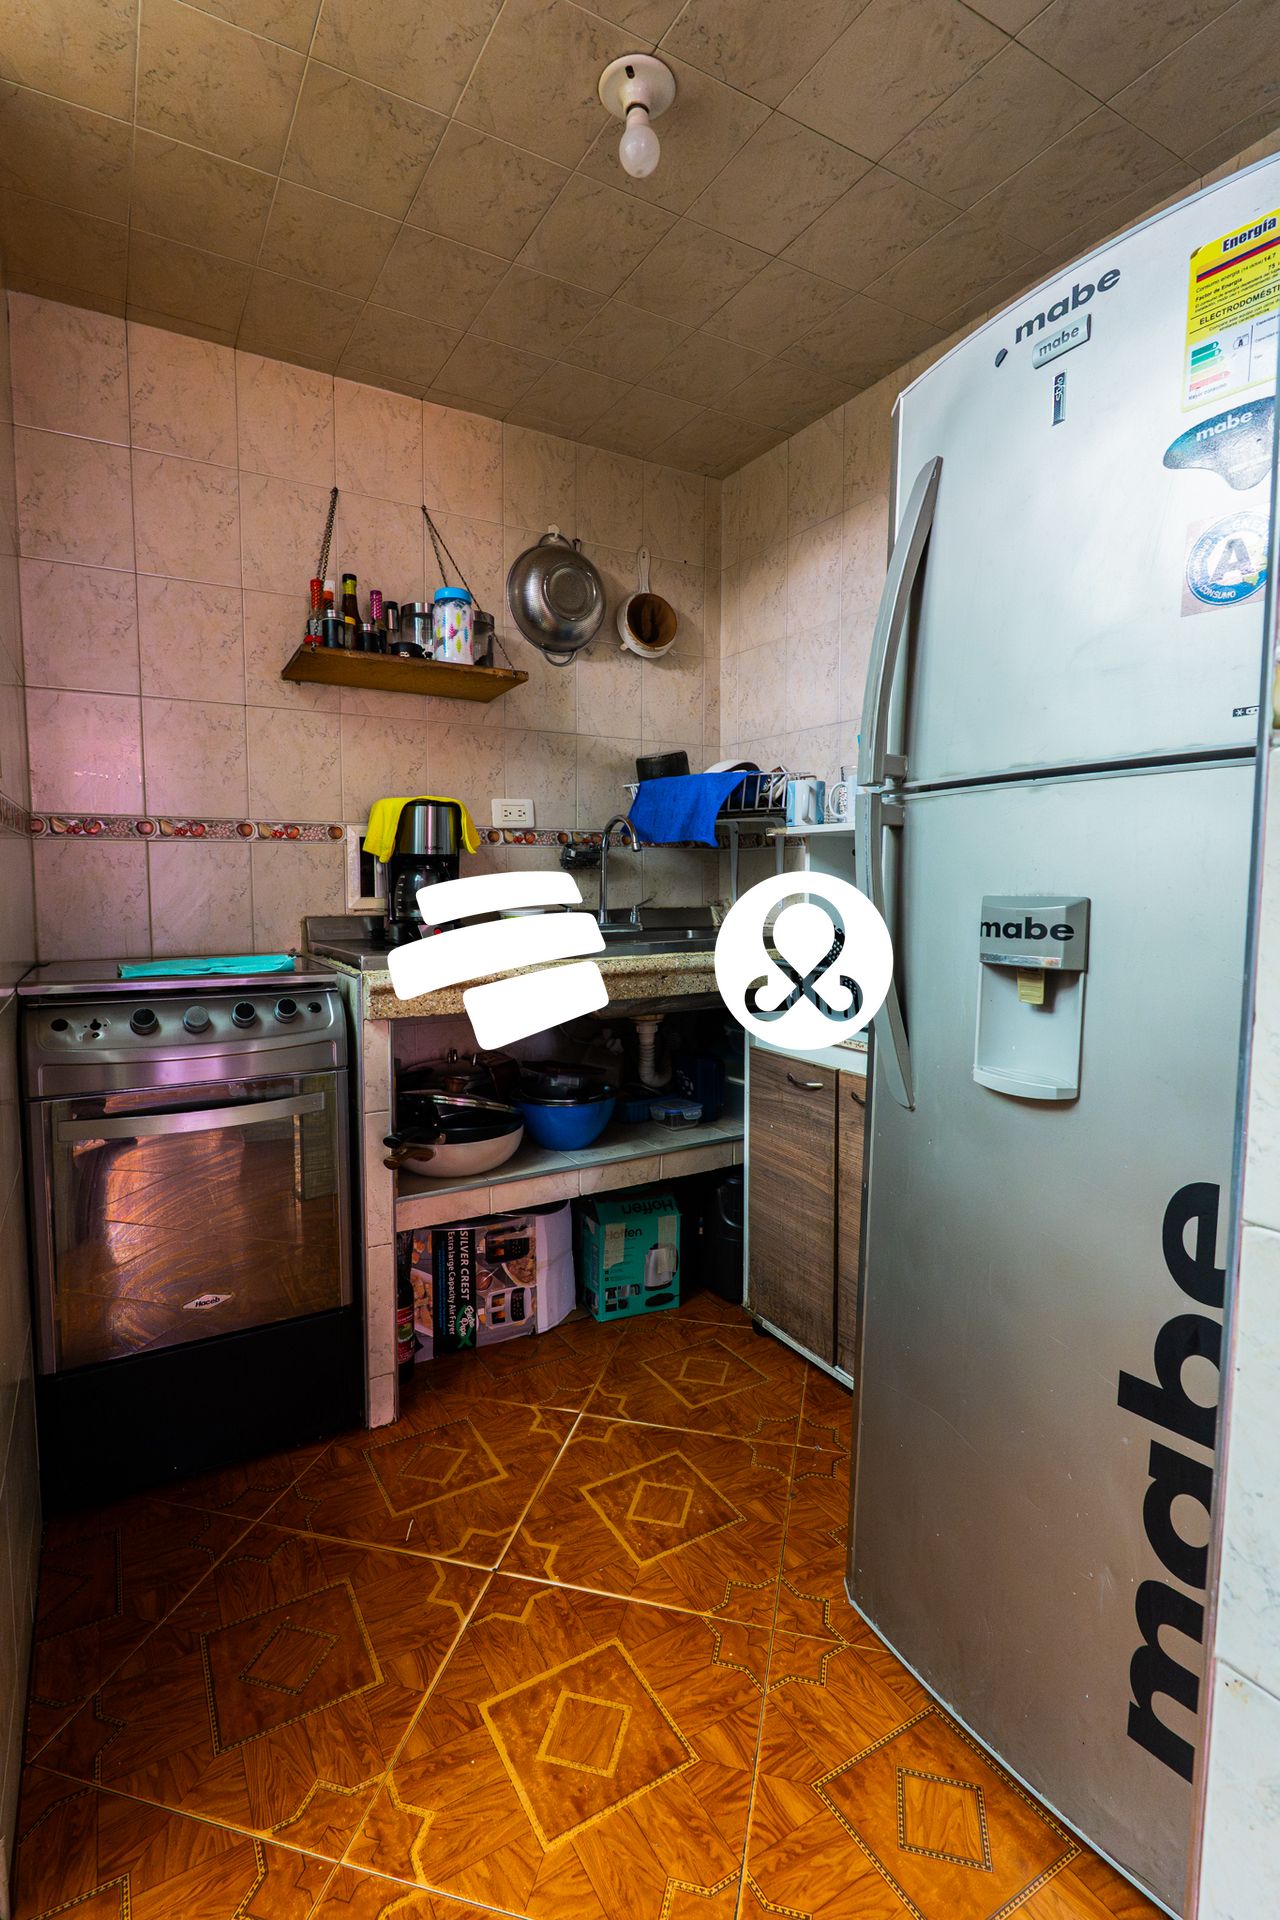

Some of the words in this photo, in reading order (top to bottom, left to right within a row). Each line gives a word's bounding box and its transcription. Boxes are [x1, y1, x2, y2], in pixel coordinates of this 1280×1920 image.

[1222, 218, 1277, 252] Energía
[1015, 269, 1121, 344] mabe
[1039, 326, 1080, 356] mabe
[1196, 411, 1253, 441] mabe
[1210, 538, 1253, 582] A
[1199, 585, 1237, 599] CONSUMO
[980, 916, 1075, 941] mabe
[622, 1199, 675, 1215] Hoffen
[447, 1231, 456, 1251] Extra
[460, 1231, 469, 1266] SILVER
[446, 1272, 456, 1304] Capacity
[460, 1268, 470, 1300] CREST
[448, 1305, 456, 1315] Air
[447, 1316, 456, 1335] Fryer
[1117, 1181, 1227, 1785] mabe
